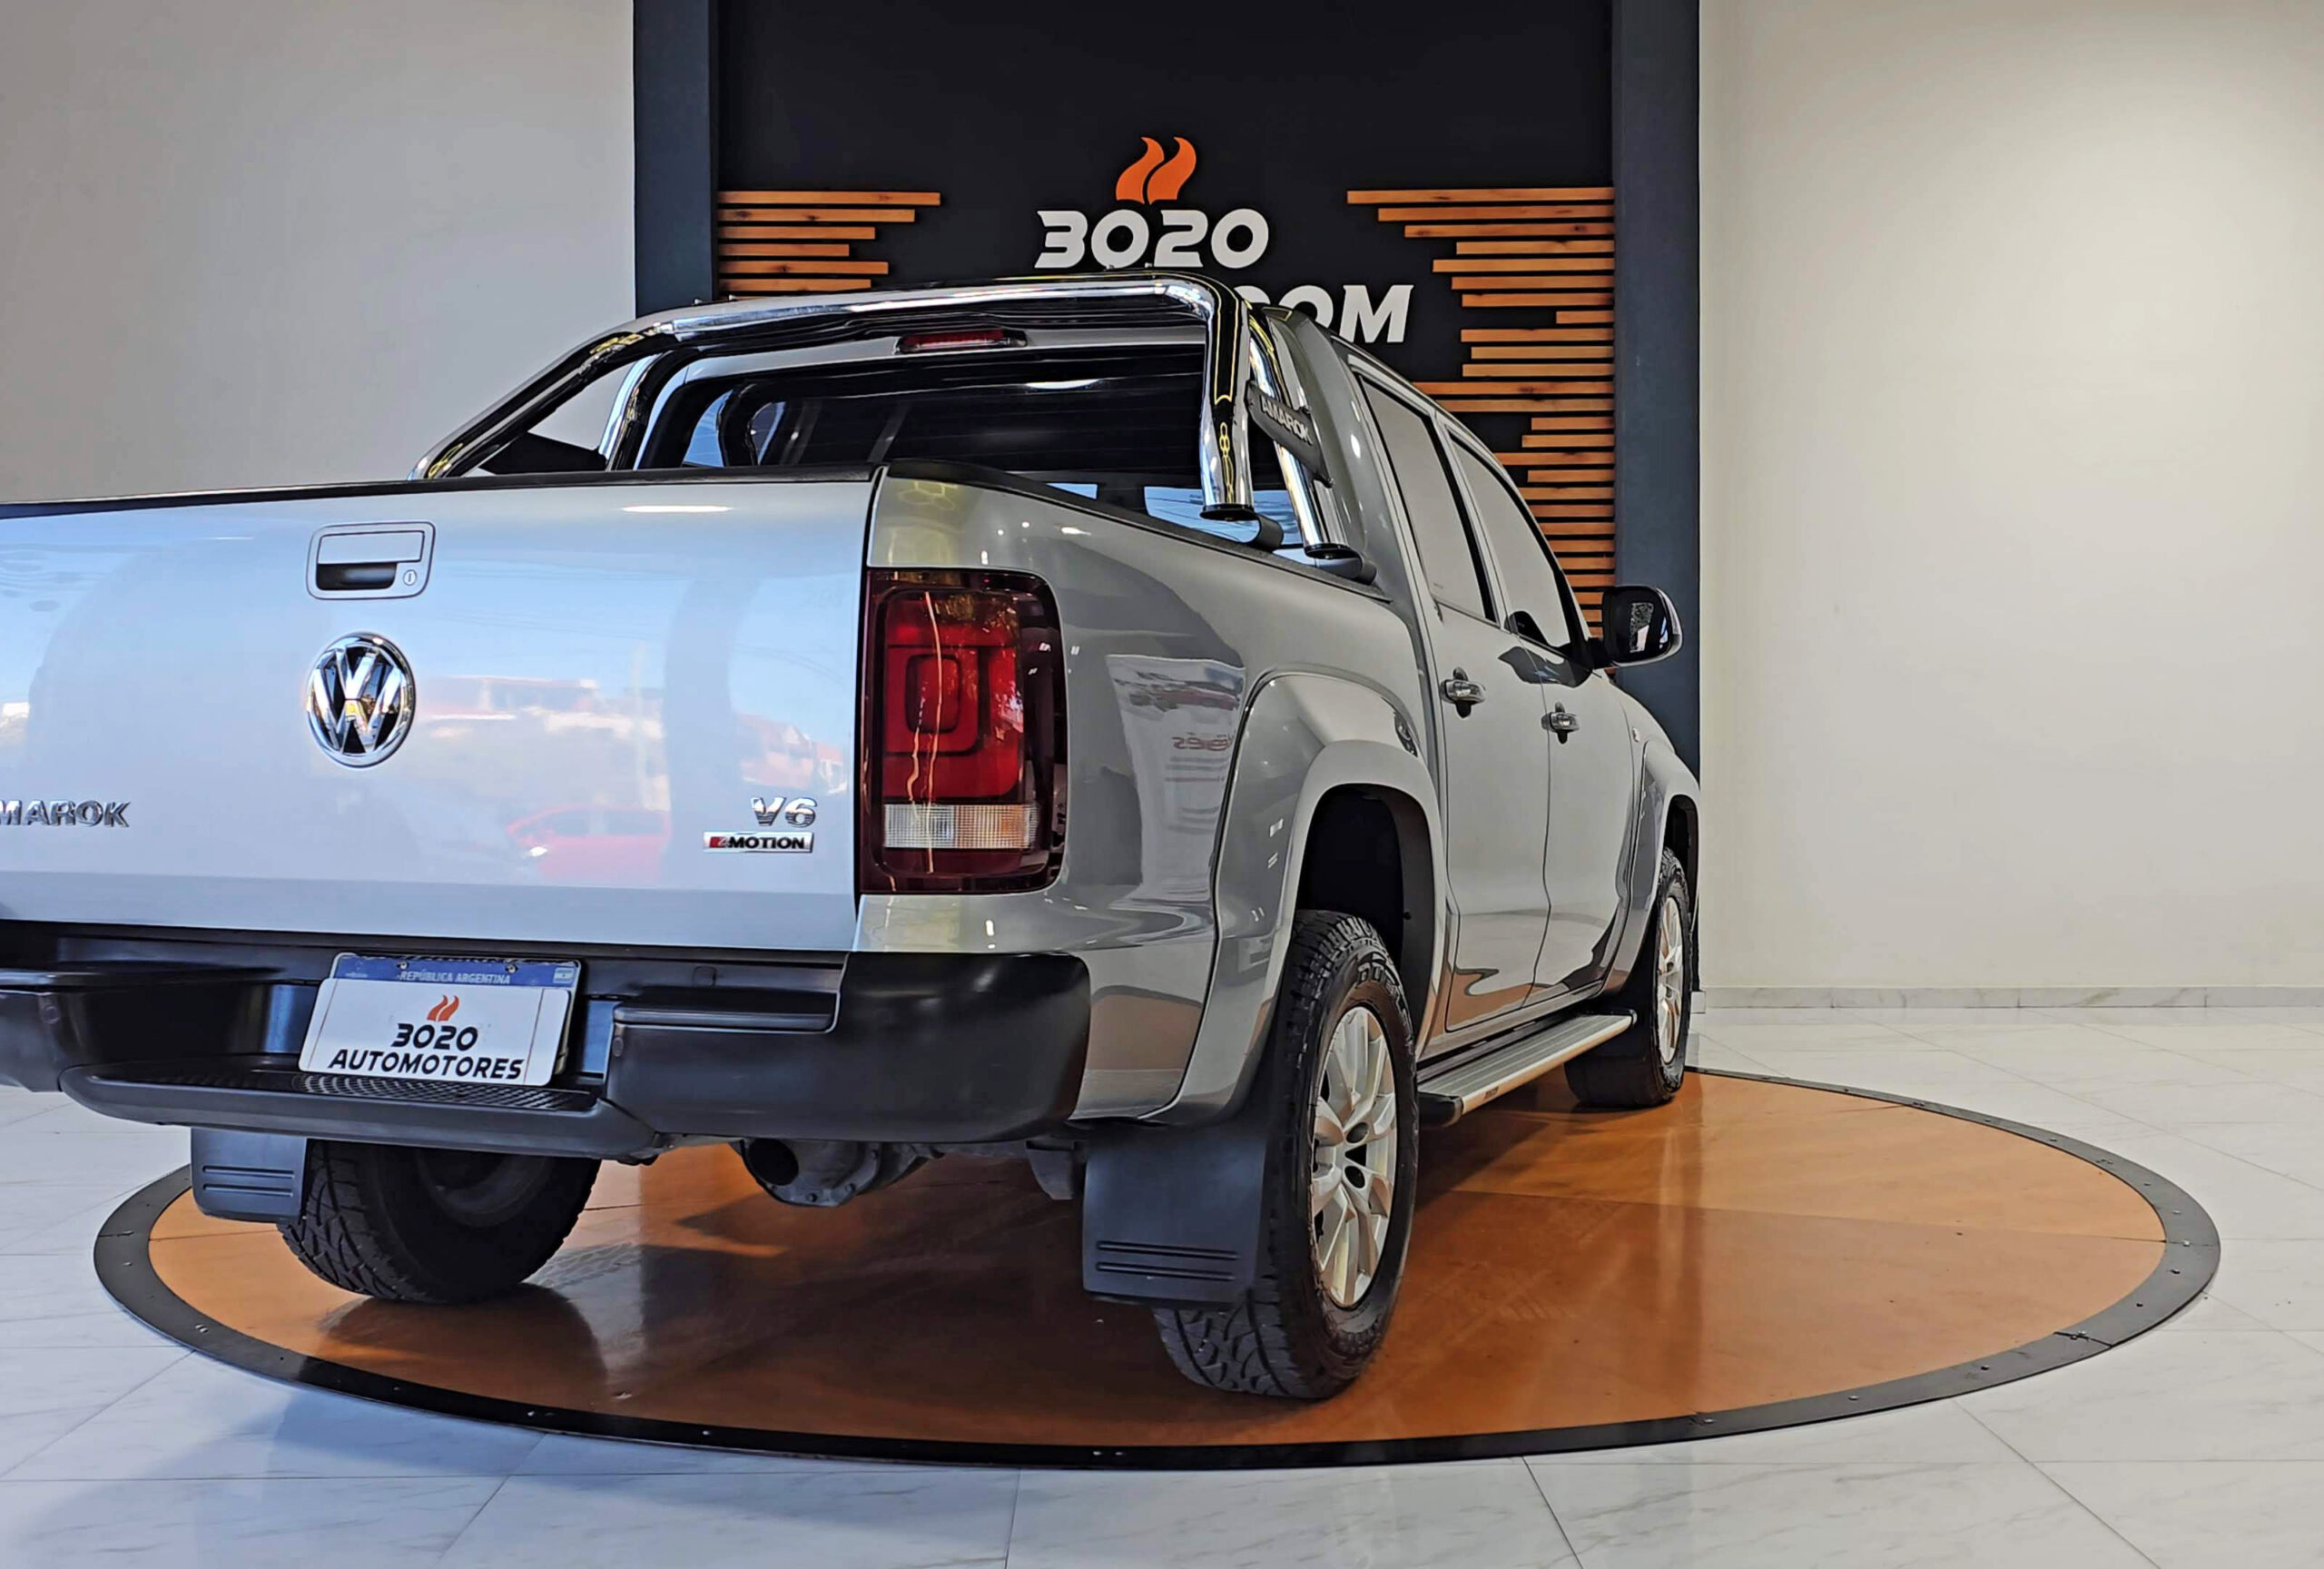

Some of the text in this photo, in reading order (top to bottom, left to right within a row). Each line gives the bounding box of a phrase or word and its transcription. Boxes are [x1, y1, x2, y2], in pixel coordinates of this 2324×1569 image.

[1035, 209, 1269, 269] 3020
[1259, 394, 1313, 446] AMAROK
[751, 797, 817, 827] V6
[455, 972, 510, 984] ARGENTINA
[391, 1023, 478, 1051] 3020
[328, 1050, 525, 1080] AUTOMOTORES
